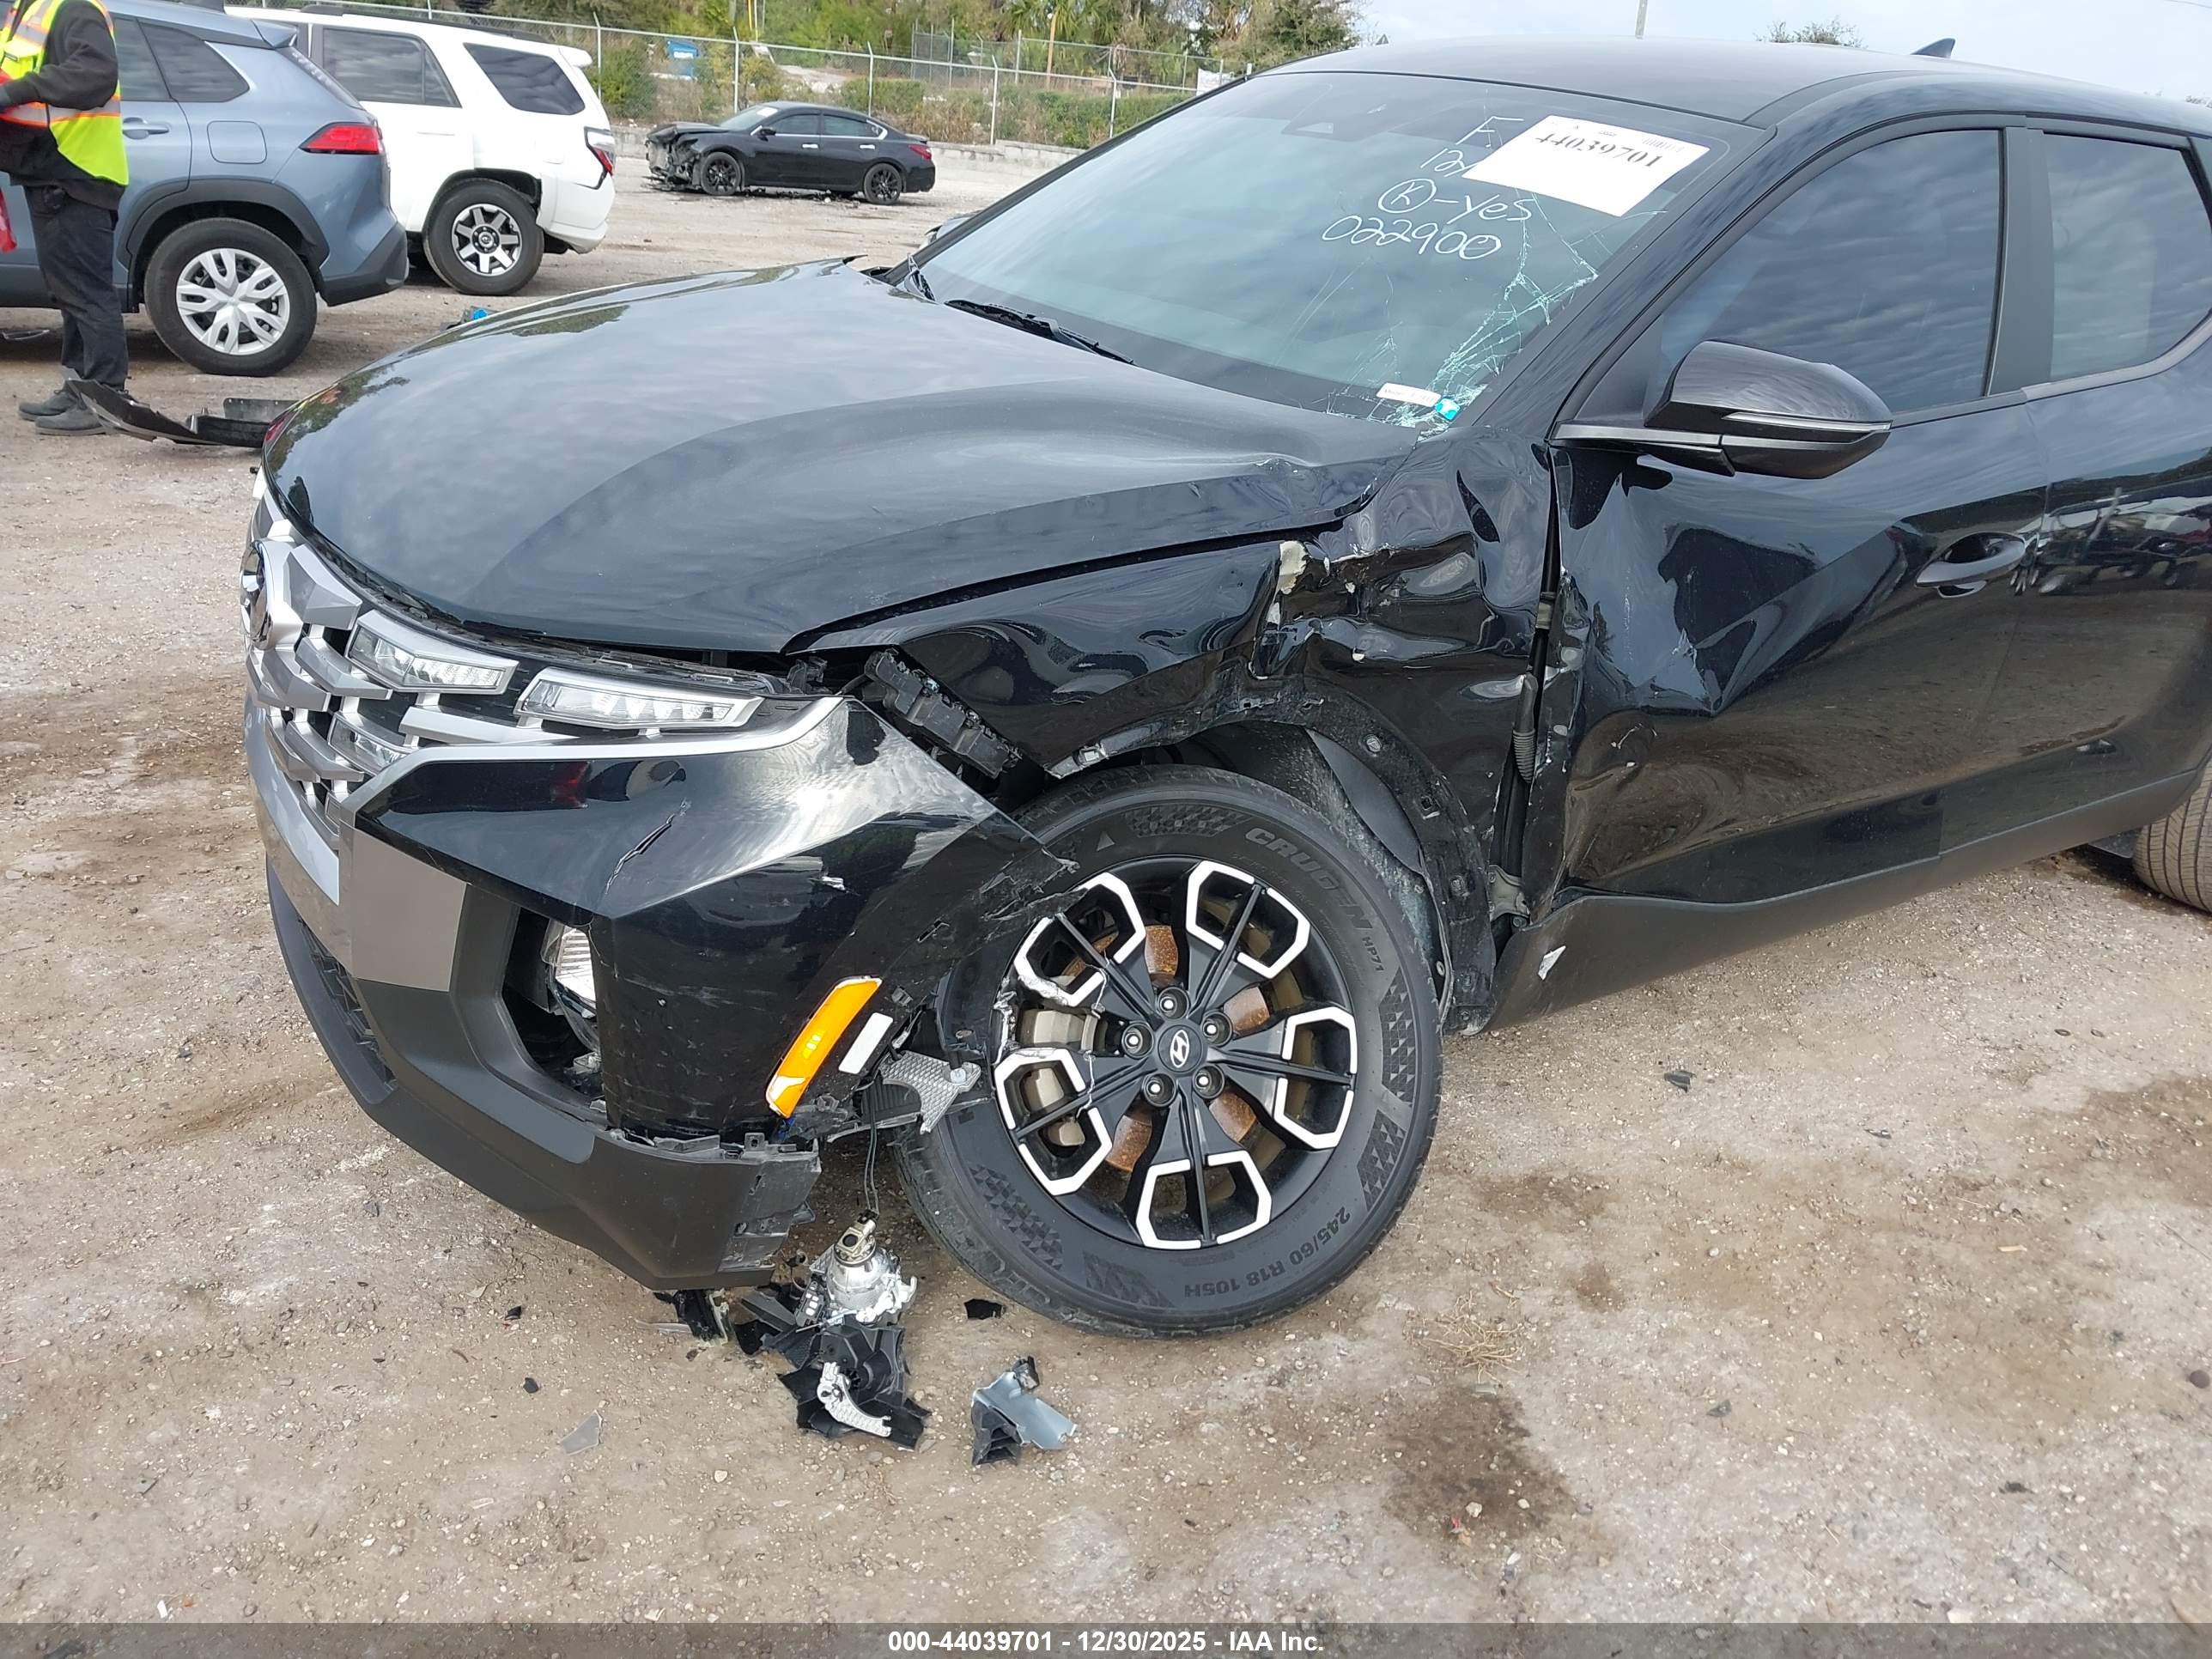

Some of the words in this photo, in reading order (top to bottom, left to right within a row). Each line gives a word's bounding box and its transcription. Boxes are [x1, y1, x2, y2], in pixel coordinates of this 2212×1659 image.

[1534, 132, 1663, 167] 44039701
[1322, 216, 1501, 260] 022900
[1361, 937, 1385, 972] HP71
[1289, 1206, 1351, 1265] 245/60
[1184, 1279, 1240, 1297] 105H
[1245, 1261, 1285, 1286] R18
